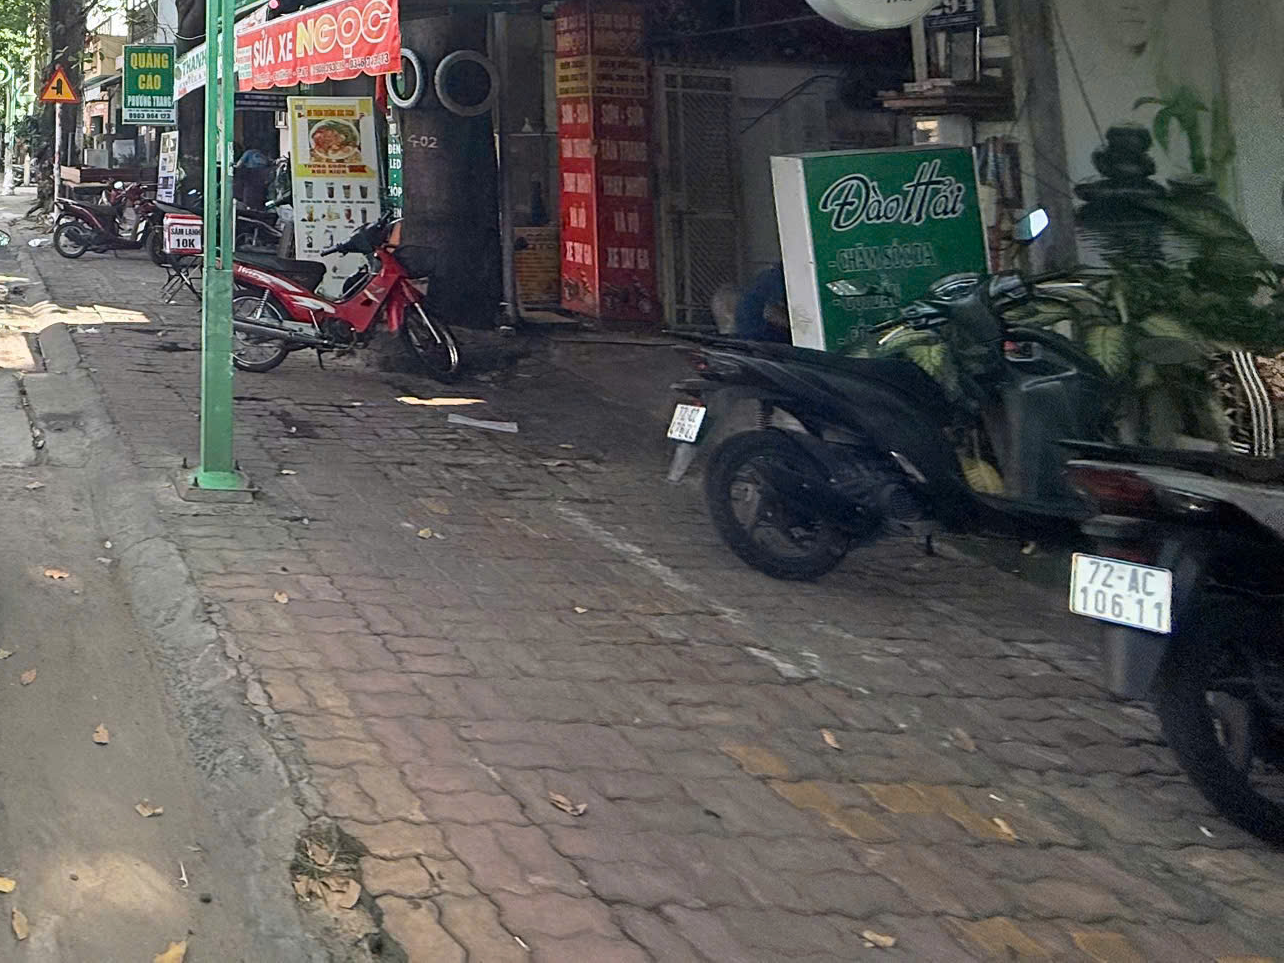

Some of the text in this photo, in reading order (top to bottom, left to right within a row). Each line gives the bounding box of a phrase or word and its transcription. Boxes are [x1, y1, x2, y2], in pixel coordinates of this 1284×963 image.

[253, 30, 275, 68] SỬA
[278, 31, 294, 62] XE
[389, 160, 402, 170] LED
[819, 158, 966, 232] Đào Hải
[176, 238, 196, 249] 10K
[1089, 560, 1155, 597] 72-AC
[1080, 586, 1164, 628] 106.11
